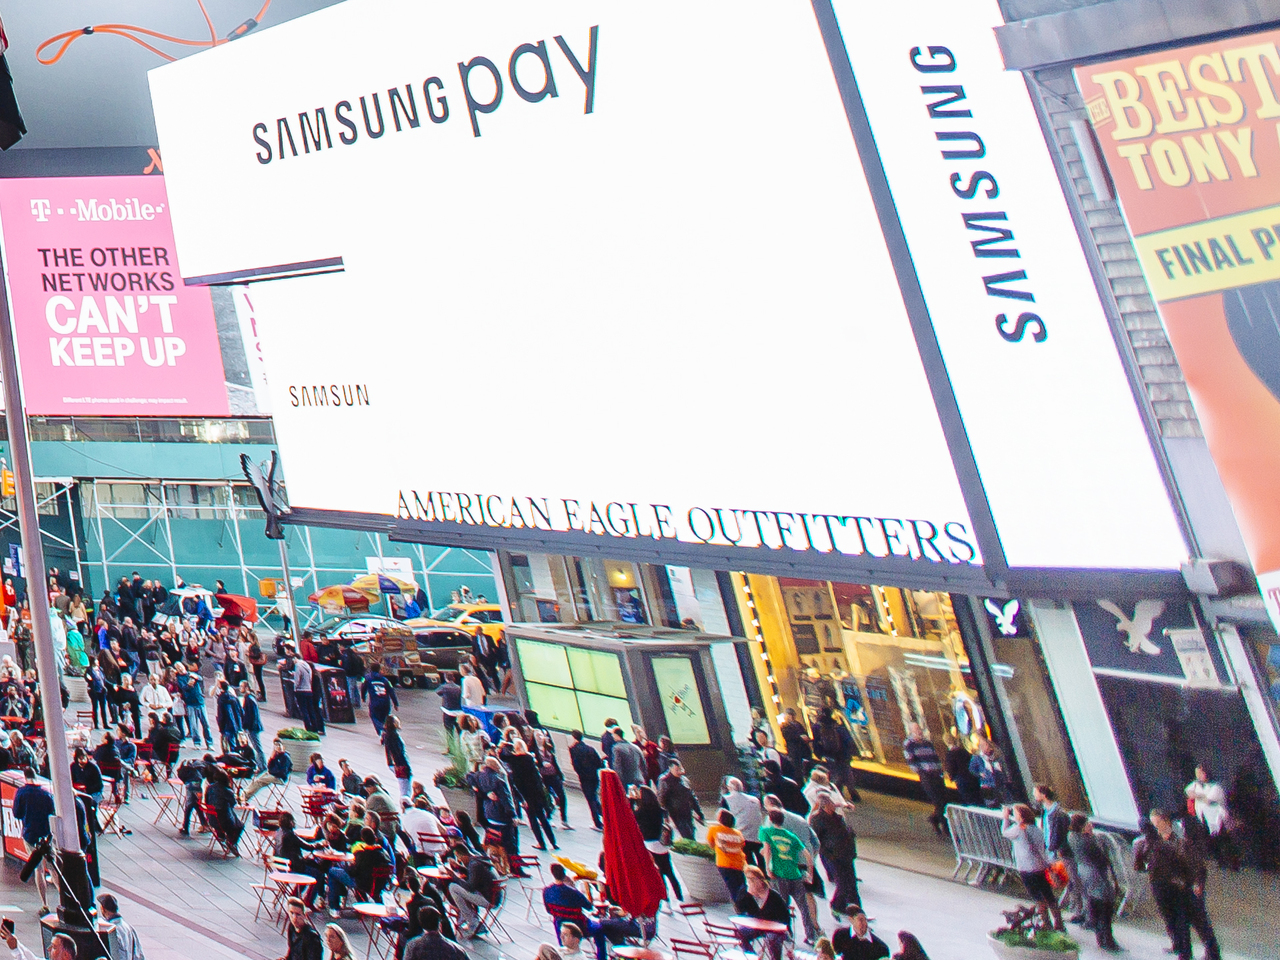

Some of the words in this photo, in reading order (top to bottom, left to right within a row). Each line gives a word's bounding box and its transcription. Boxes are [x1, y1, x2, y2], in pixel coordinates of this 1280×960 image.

[252, 76, 450, 165] SAMSUNG
[458, 25, 600, 137] pay
[1091, 41, 1280, 141] BEST
[1117, 126, 1260, 191] TONY
[909, 44, 1049, 344] SAMSUNG
[37, 248, 85, 268] THE
[90, 247, 170, 267] OTHER
[1154, 232, 1255, 281] FINAL
[41, 271, 175, 292] NETWORKS
[44, 294, 178, 335] CAN'T
[49, 336, 136, 367] KEEP
[139, 336, 186, 367] UP
[288, 383, 371, 408] SAMSUN
[396, 488, 553, 531] AMERICAN
[559, 498, 677, 541] EAGLE
[686, 506, 980, 565] OUTFITTERS
